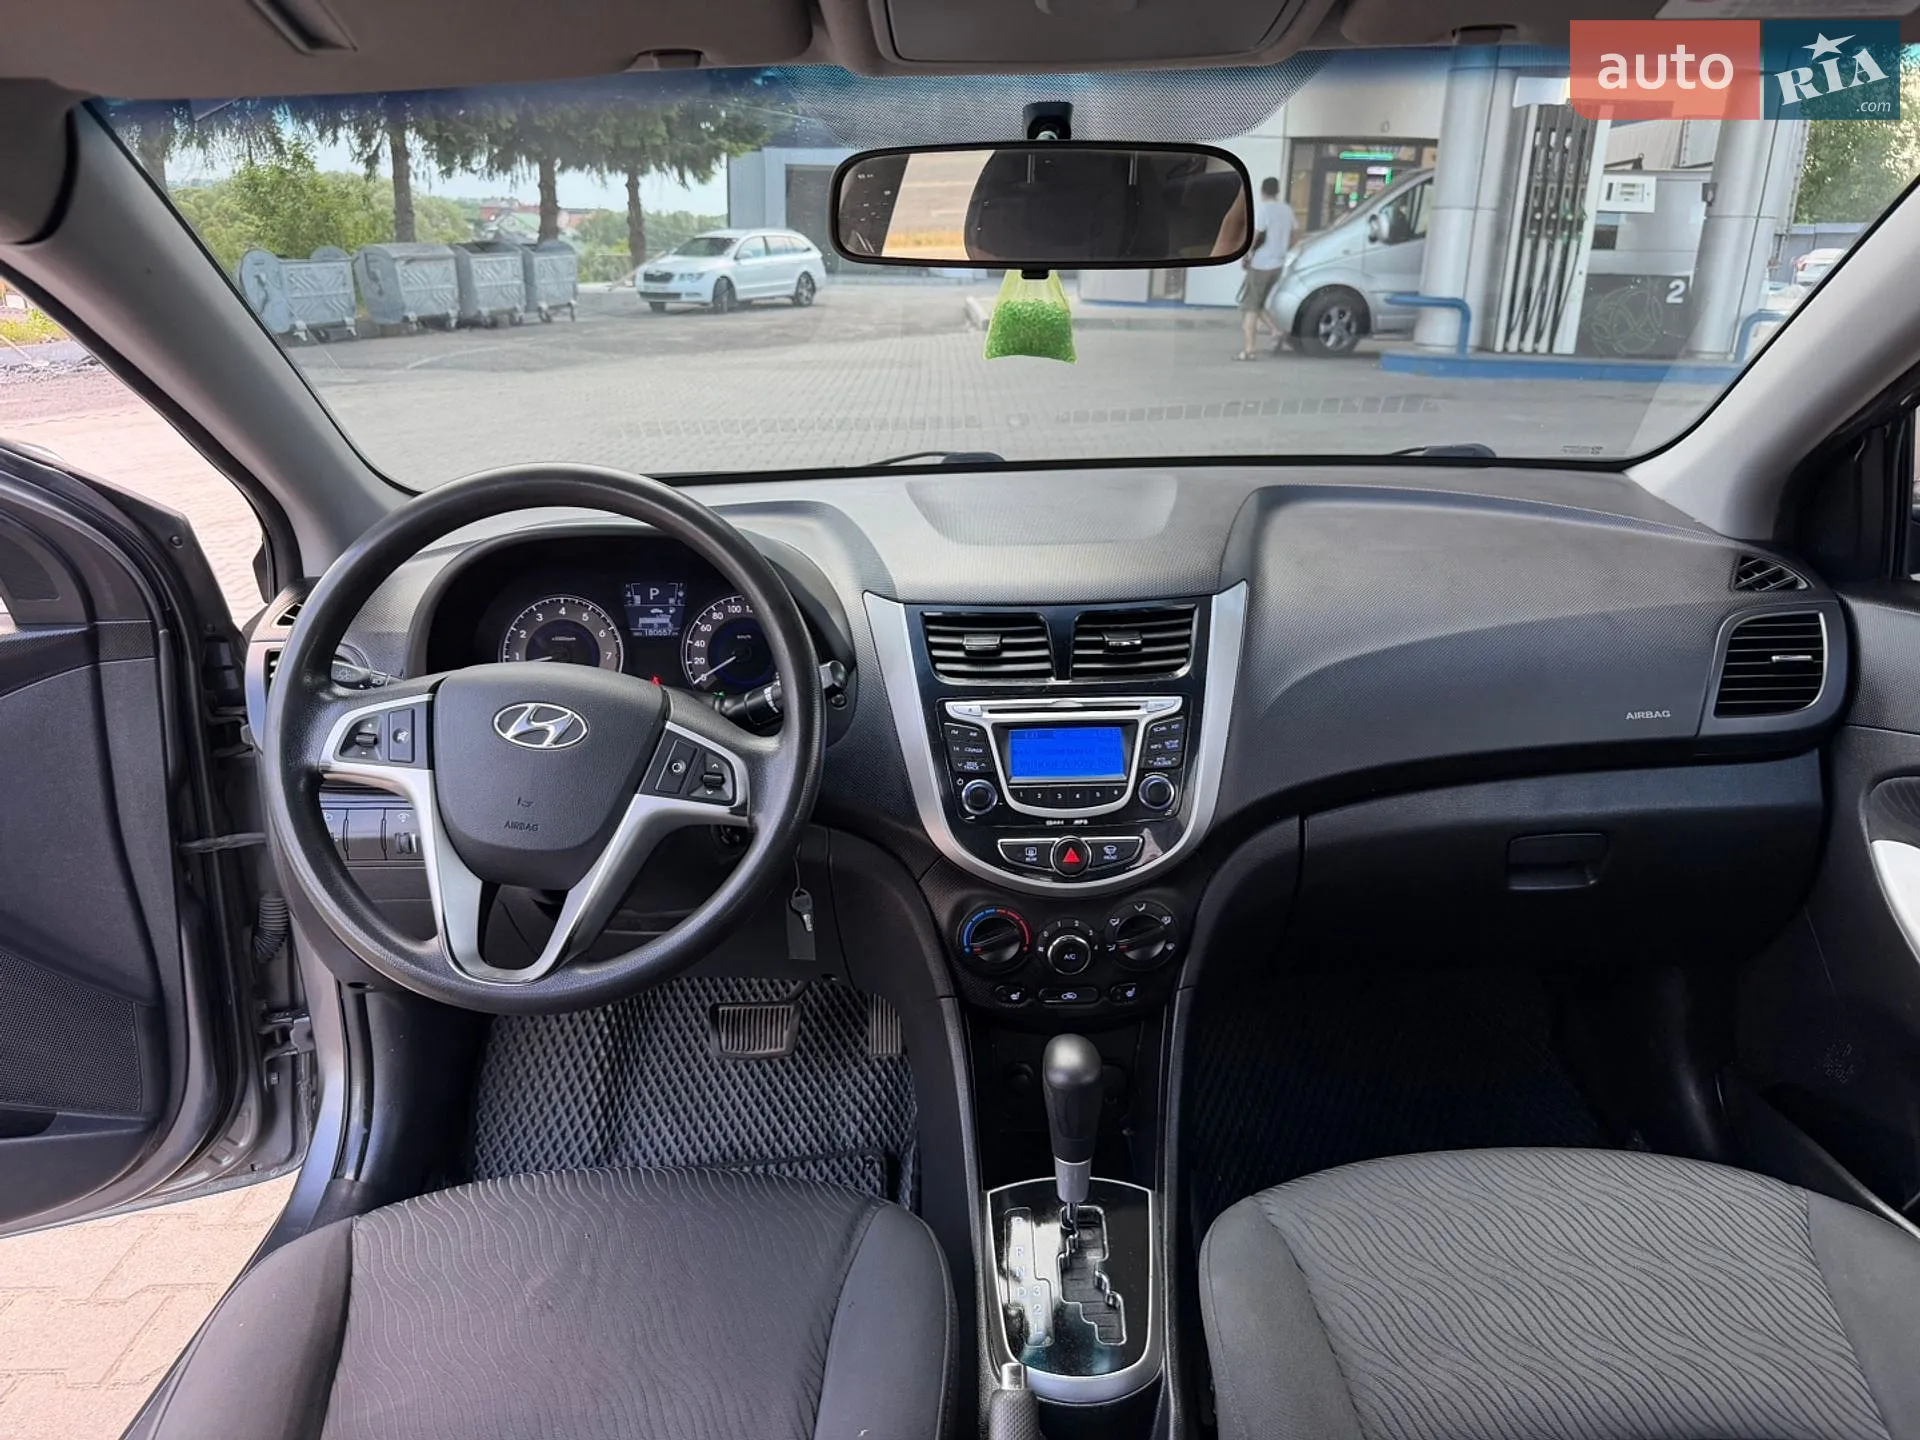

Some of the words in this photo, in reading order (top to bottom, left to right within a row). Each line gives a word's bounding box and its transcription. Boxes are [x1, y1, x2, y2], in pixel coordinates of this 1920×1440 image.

[1666, 280, 1686, 303] 2
[650, 587, 660, 600] P
[558, 606, 567, 615] 4
[727, 605, 742, 613] 100
[536, 613, 544, 622] 3
[582, 613, 589, 622] 5
[711, 611, 724, 620] 80
[700, 624, 712, 632] 60
[519, 630, 527, 639] 2
[599, 629, 606, 637] 6
[694, 640, 706, 648] 40
[514, 652, 520, 661] 1
[605, 651, 612, 660] 7
[694, 657, 706, 665] 20
[1625, 710, 1671, 720] AIRBAG
[504, 820, 539, 831] AIRBAG
[1032, 1286, 1041, 1296] 3
[1033, 1303, 1042, 1315] 2
